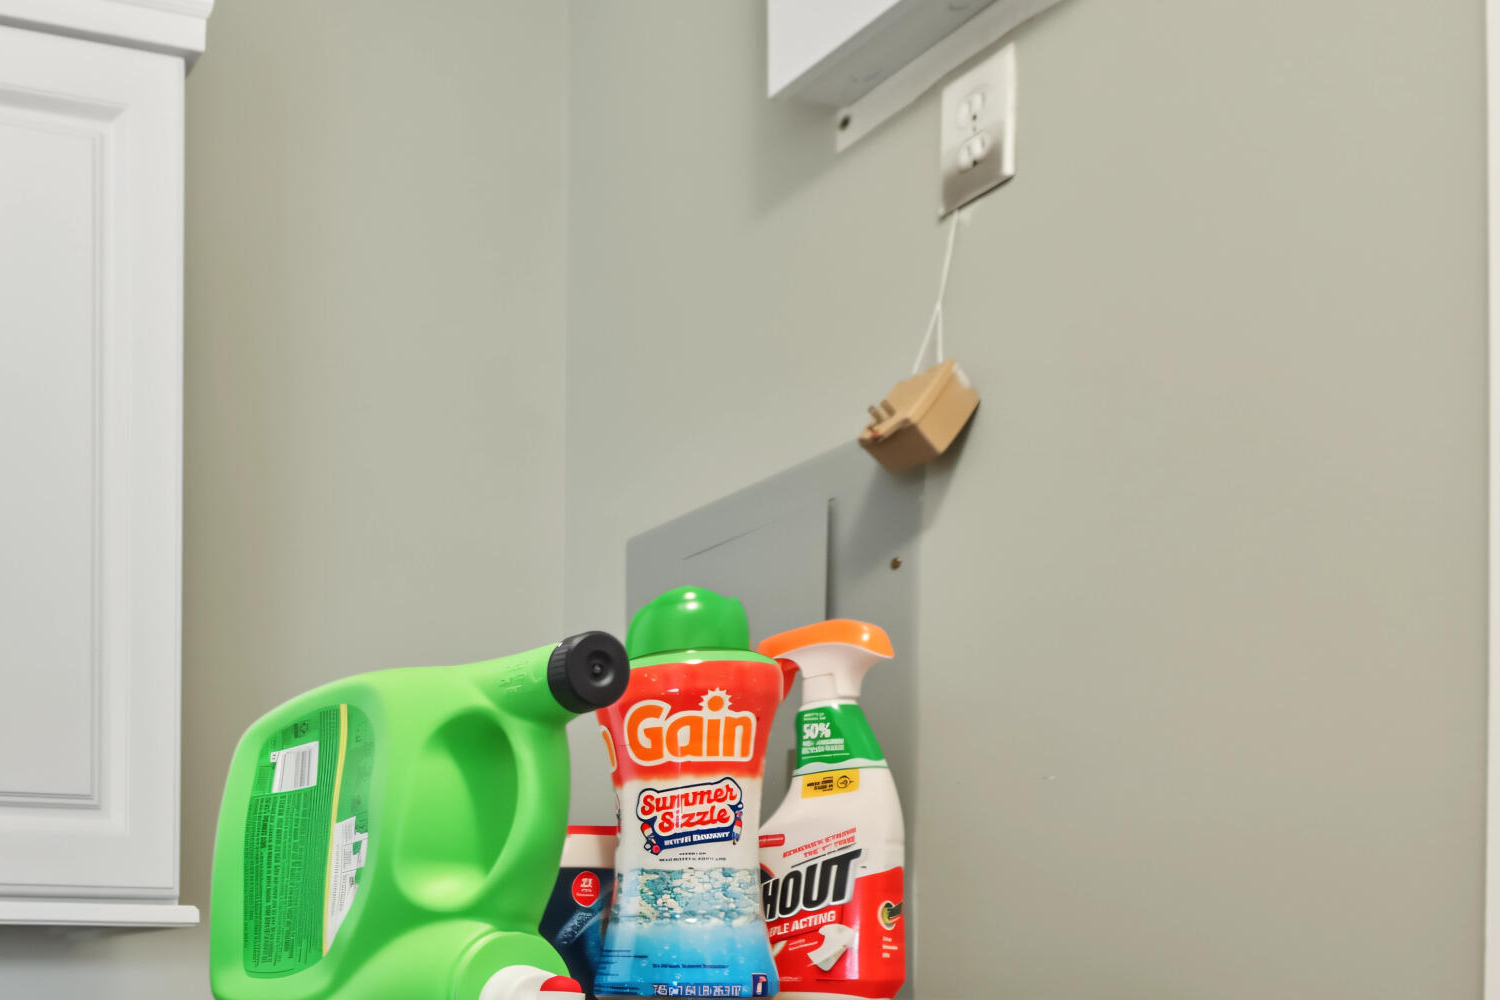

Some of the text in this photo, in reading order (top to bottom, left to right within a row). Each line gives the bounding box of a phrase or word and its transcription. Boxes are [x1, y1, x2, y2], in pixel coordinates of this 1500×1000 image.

[626, 692, 755, 763] Gain
[803, 723, 830, 739] 50%
[641, 784, 737, 815] Summer
[659, 806, 730, 833] Sizzle
[762, 848, 862, 921] HOUT
[790, 910, 837, 932] ACTING
